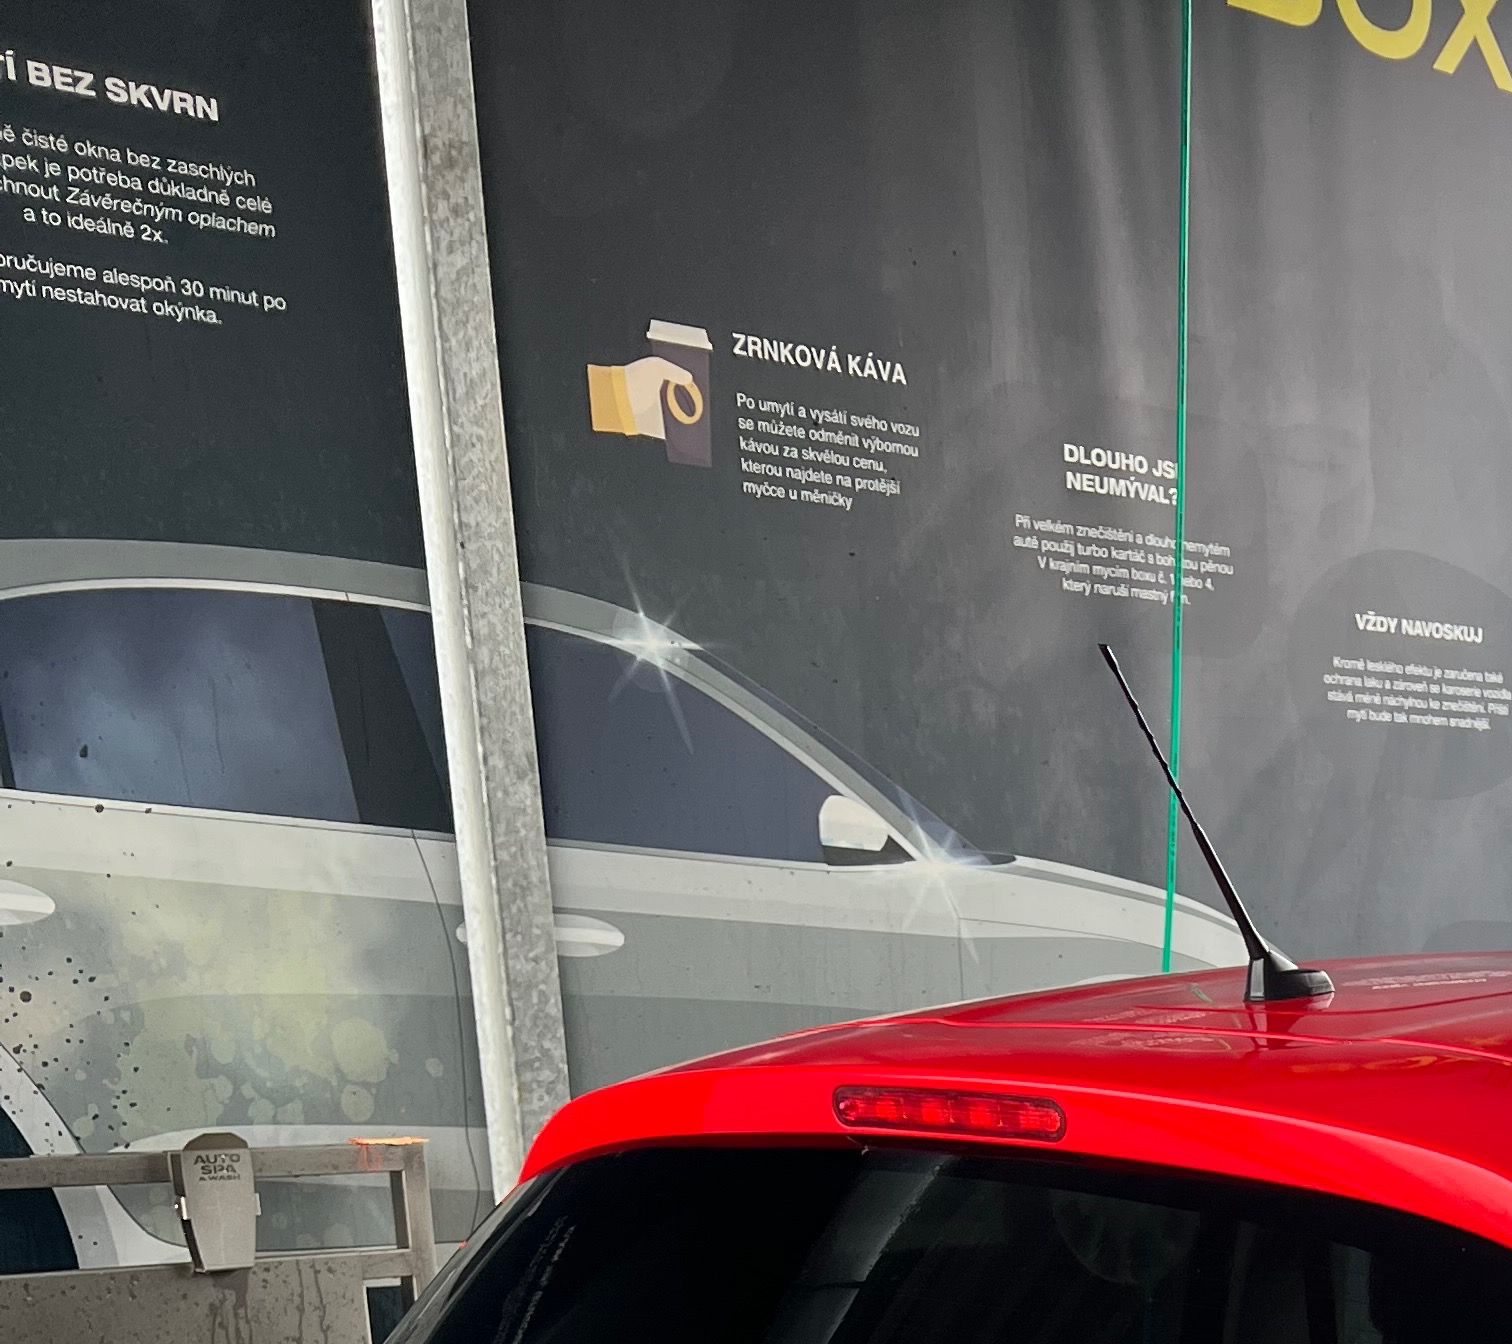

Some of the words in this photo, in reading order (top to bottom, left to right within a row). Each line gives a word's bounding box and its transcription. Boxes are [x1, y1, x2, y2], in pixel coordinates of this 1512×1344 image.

[26, 59, 97, 97] BEZ
[104, 76, 219, 121] SKVRN
[0, 124, 16, 143] ě
[21, 127, 69, 153] čisté
[73, 139, 122, 164] okna
[126, 147, 161, 171] bez
[166, 162, 256, 188] zaschlých
[43, 156, 62, 179] je
[66, 165, 143, 192] potřeba
[147, 176, 231, 206] důkladně
[235, 194, 273, 214] celé
[0, 174, 60, 202] hnout
[65, 187, 183, 223] Závěrečným
[187, 210, 276, 238] oplachem
[22, 207, 36, 222] a
[41, 207, 62, 226] to
[66, 210, 135, 238] ideálně
[140, 223, 169, 244] 2x.
[41, 285, 148, 313] nestahovat
[152, 299, 222, 325] okýnka.
[102, 267, 176, 293] alespoň
[180, 278, 204, 298] 30
[208, 285, 260, 308] minut
[263, 295, 287, 313] po
[732, 332, 842, 373] ZRNKOVÁ
[847, 351, 907, 385] KÁVA
[736, 392, 756, 410] Po
[758, 399, 796, 418] umytí
[798, 406, 807, 419] a
[850, 414, 888, 432] svého
[890, 421, 920, 437] vozu
[737, 417, 755, 431] se
[757, 418, 806, 439] můžete
[808, 427, 860, 448] odměnit
[739, 435, 780, 457] kávou
[782, 446, 799, 459] za
[801, 446, 850, 467] skvělou
[1063, 443, 1149, 474] DLOUHO
[740, 457, 783, 477] kterou
[785, 465, 833, 485] najdete
[835, 474, 853, 488] na
[742, 481, 787, 499] myčce
[788, 488, 798, 500] u
[1065, 471, 1179, 506] NEUMÝVAL?
[1354, 610, 1398, 634] VŽDY
[1400, 618, 1484, 644] NAVOSKUJ
[193, 1153, 241, 1165] AUTO
[200, 1164, 237, 1175] SPA
